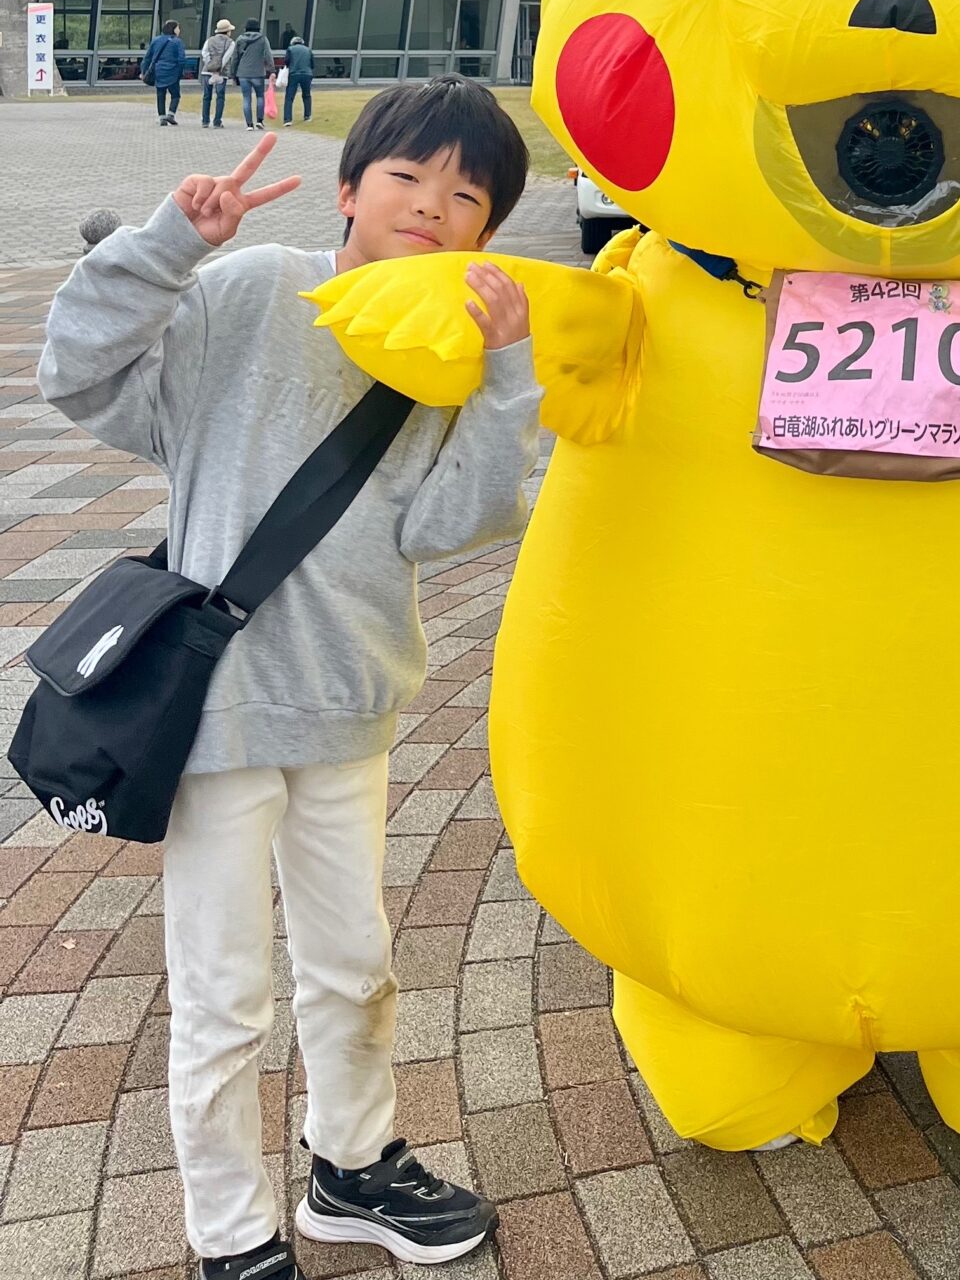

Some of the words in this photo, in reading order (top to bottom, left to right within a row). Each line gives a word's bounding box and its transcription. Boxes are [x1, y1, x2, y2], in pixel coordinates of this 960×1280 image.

[36, 14, 46, 62] 更衣室
[850, 280, 922, 303] 第42回
